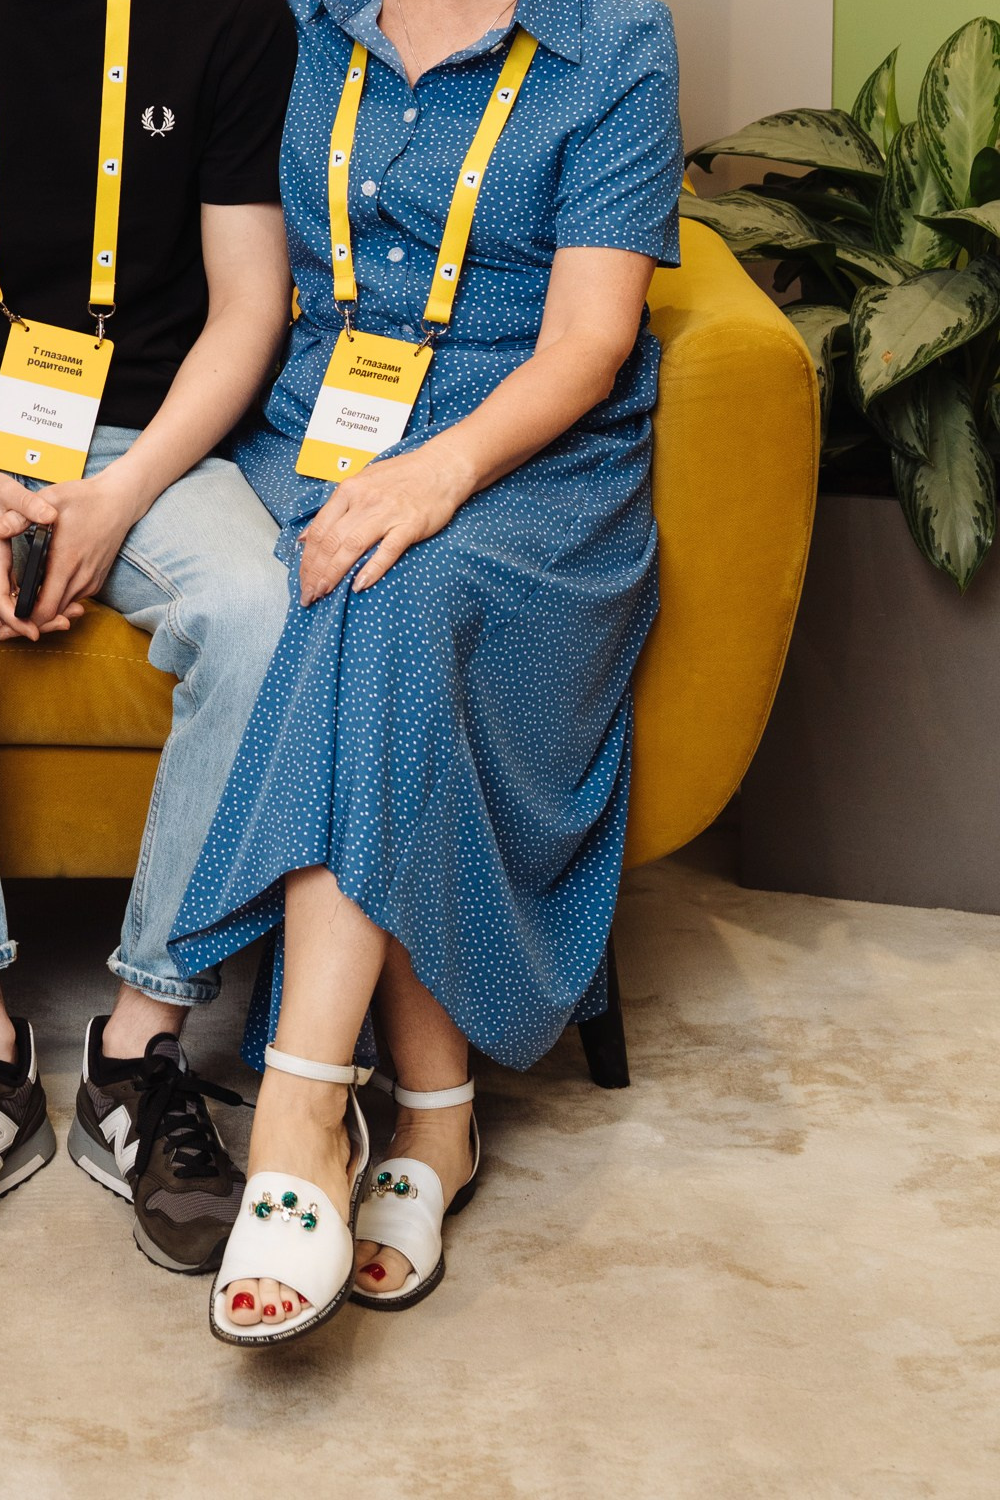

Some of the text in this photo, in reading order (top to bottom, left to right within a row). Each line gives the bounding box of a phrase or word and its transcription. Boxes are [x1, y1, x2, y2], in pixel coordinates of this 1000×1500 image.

[33, 345, 83, 366] Т глазами
[356, 355, 402, 373] Т глазами
[27, 357, 83, 377] родителей
[348, 367, 400, 384] родителей
[32, 403, 57, 416] Илья
[341, 407, 380, 423] Светлана
[20, 411, 63, 429] Разуваев
[335, 417, 378, 434] Разуваева
